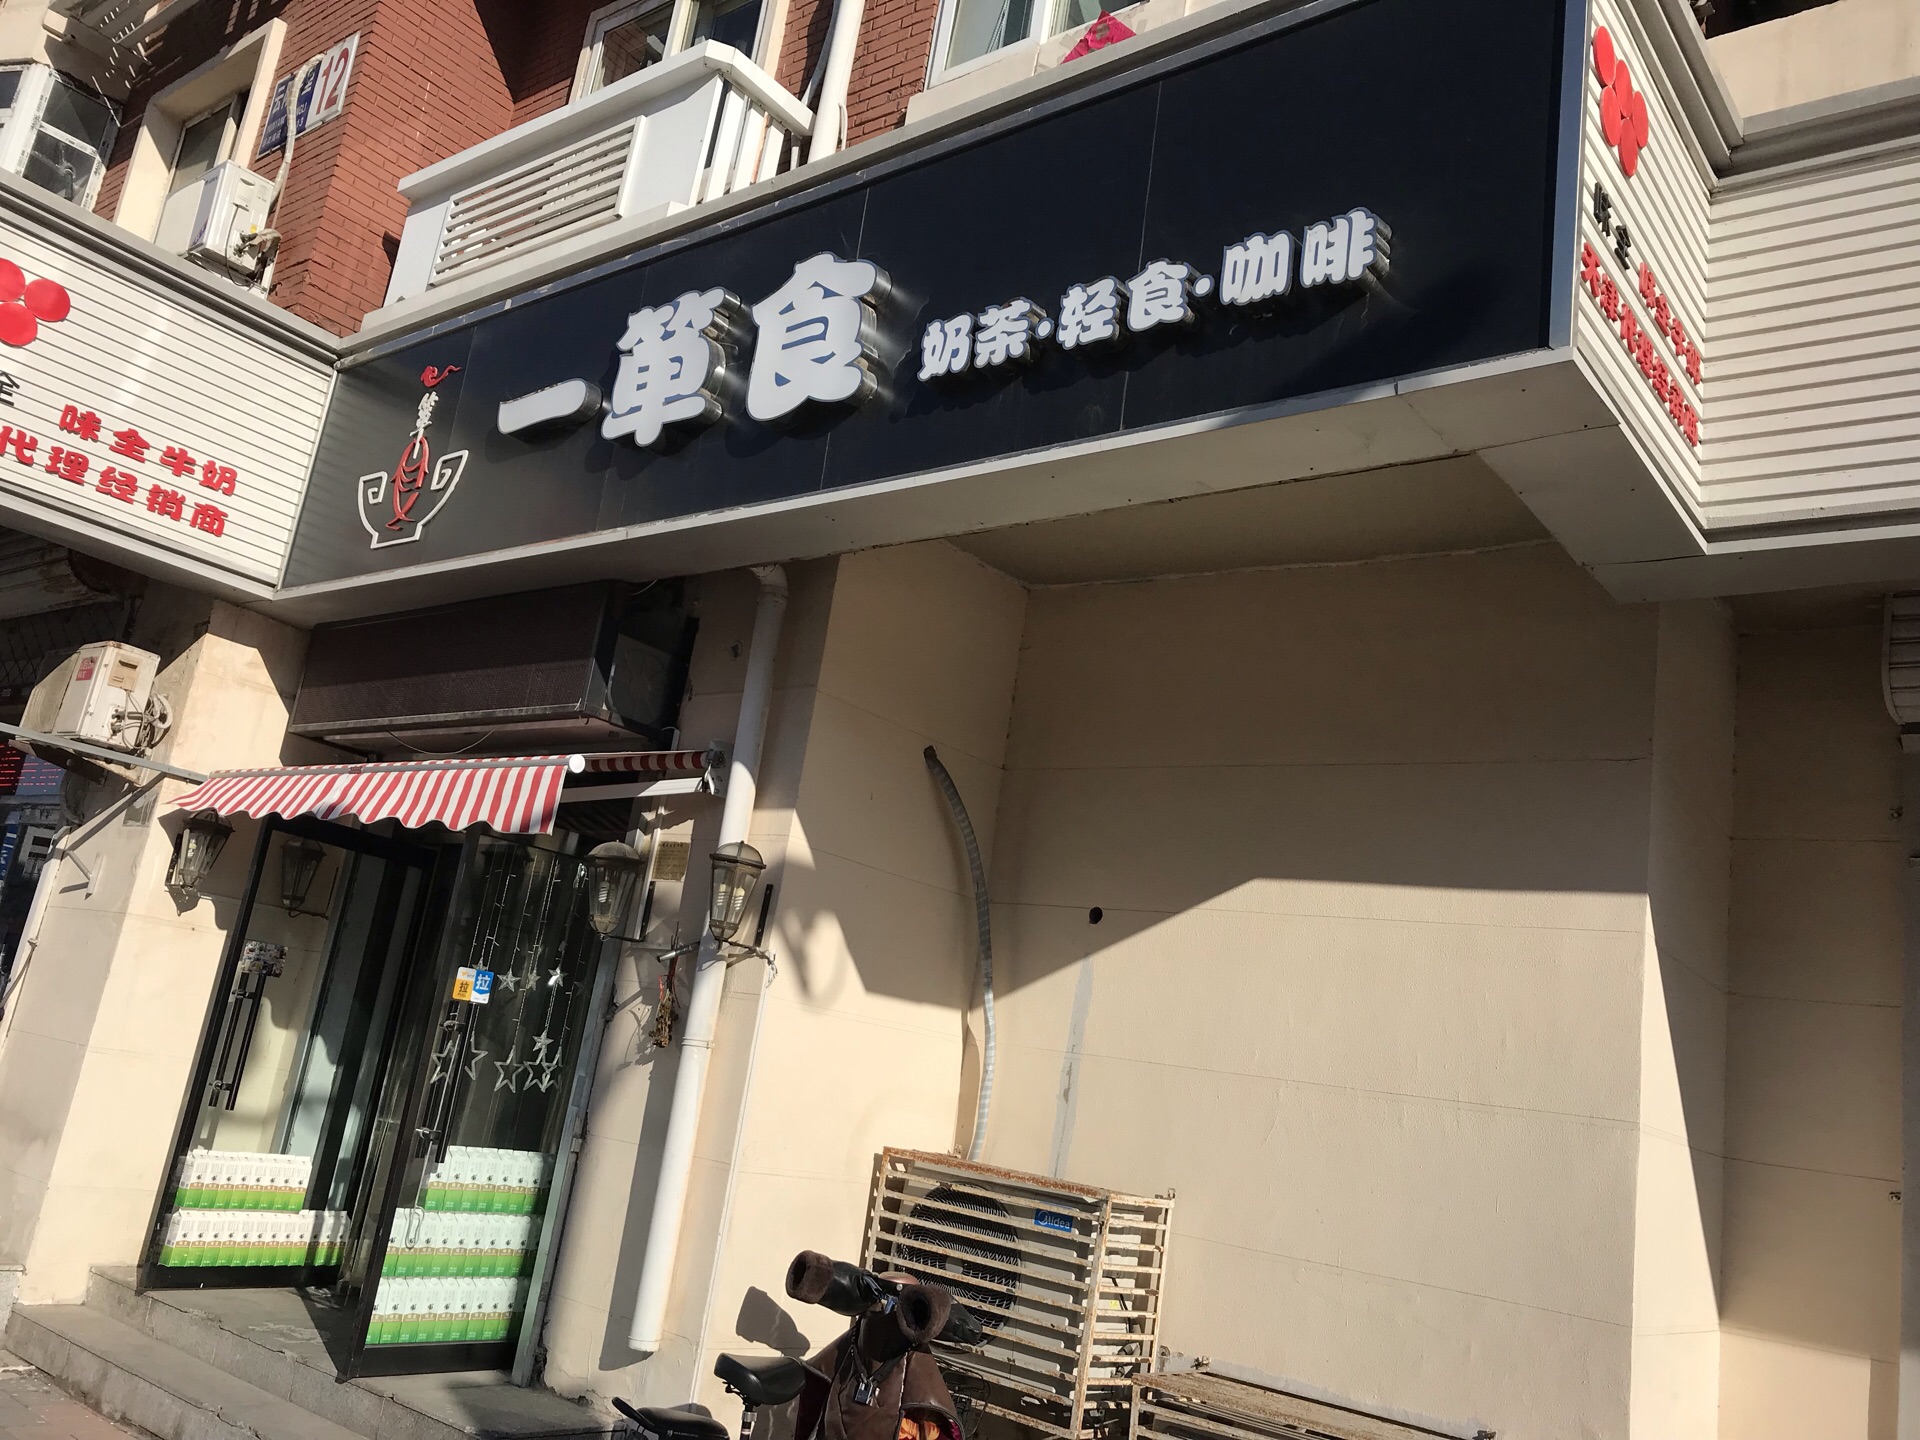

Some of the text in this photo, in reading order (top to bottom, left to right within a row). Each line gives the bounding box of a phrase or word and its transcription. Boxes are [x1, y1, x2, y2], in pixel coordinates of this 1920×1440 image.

[316, 47, 349, 115] 12
[0, 425, 229, 538] 代理经销商
[59, 404, 238, 496] 味全牛奶
[458, 981, 470, 993] 拉
[475, 973, 491, 991] 拉
